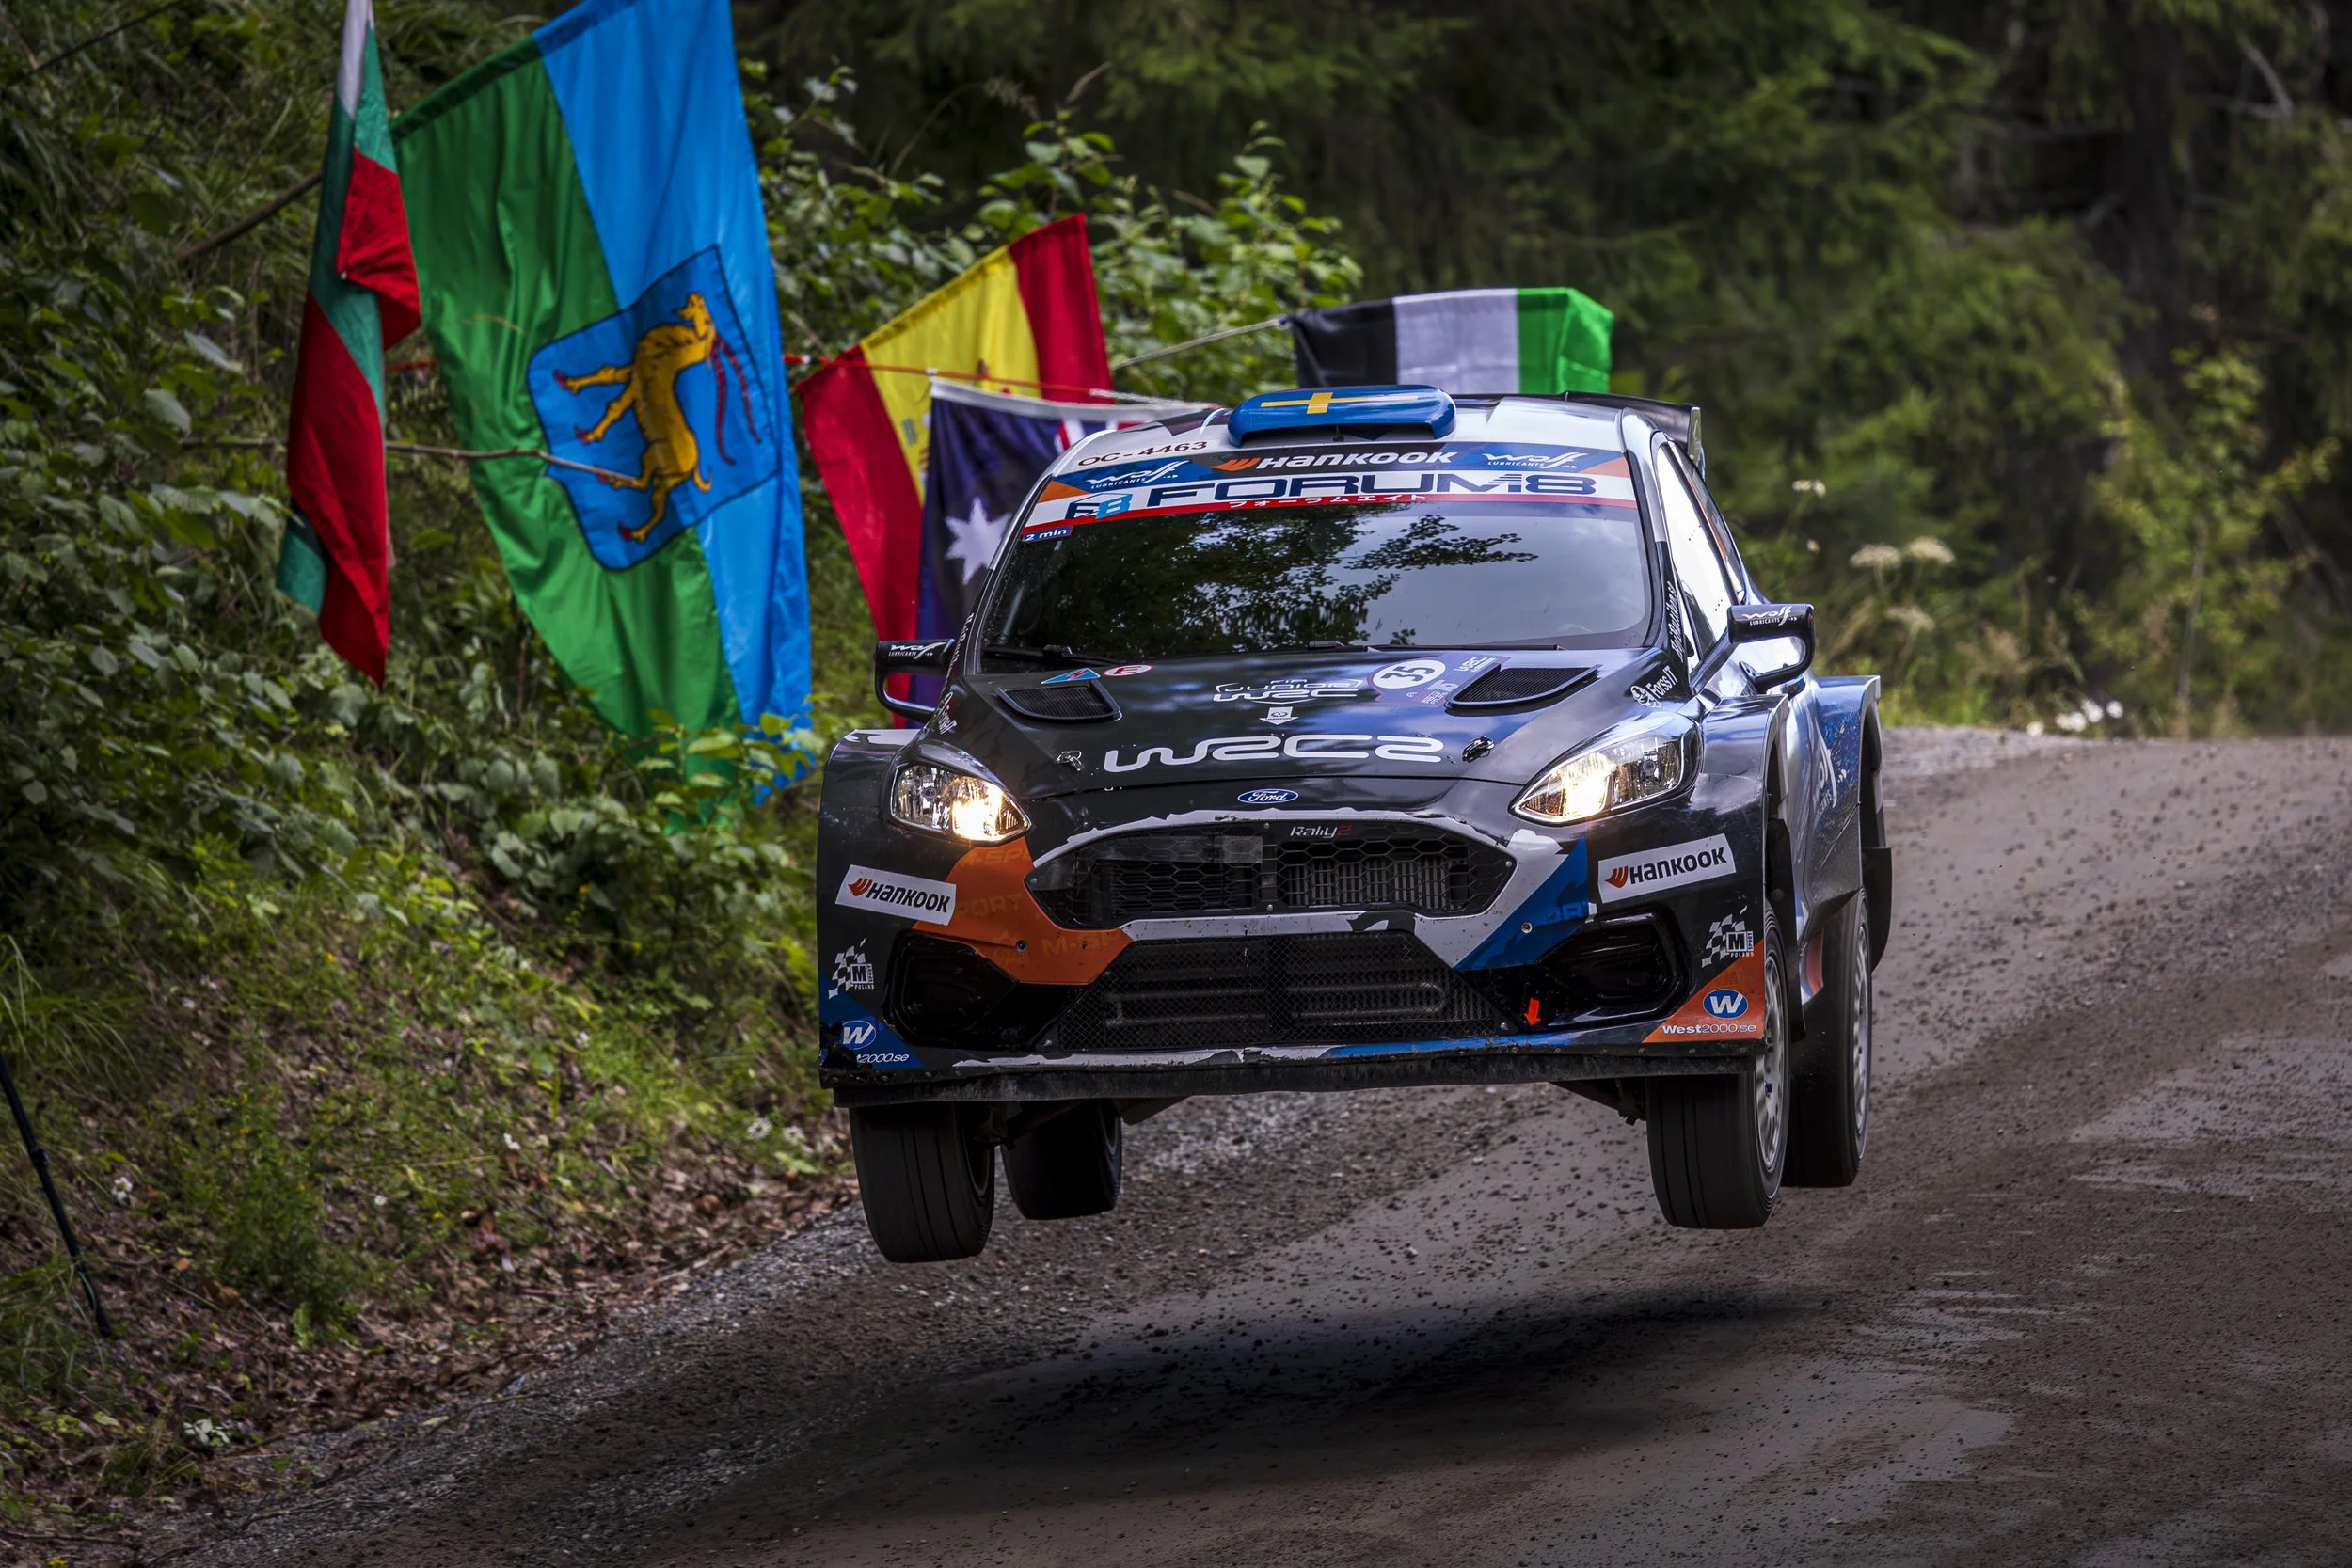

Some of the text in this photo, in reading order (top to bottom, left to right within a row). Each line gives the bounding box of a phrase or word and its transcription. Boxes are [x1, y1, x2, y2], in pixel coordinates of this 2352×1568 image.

[1090, 477, 1147, 489] LUBRICANTS
[1147, 473, 1597, 508] FORUM8
[1025, 528, 1068, 542] 2 min
[1380, 666, 1436, 682] 35
[1213, 689, 1359, 702] WRC
[1104, 735, 1444, 772] WRC2
[1248, 790, 1288, 801] Ford
[1709, 992, 1744, 1014] W
[842, 1024, 875, 1045] W
[1661, 1023, 1756, 1034] West2000.se
